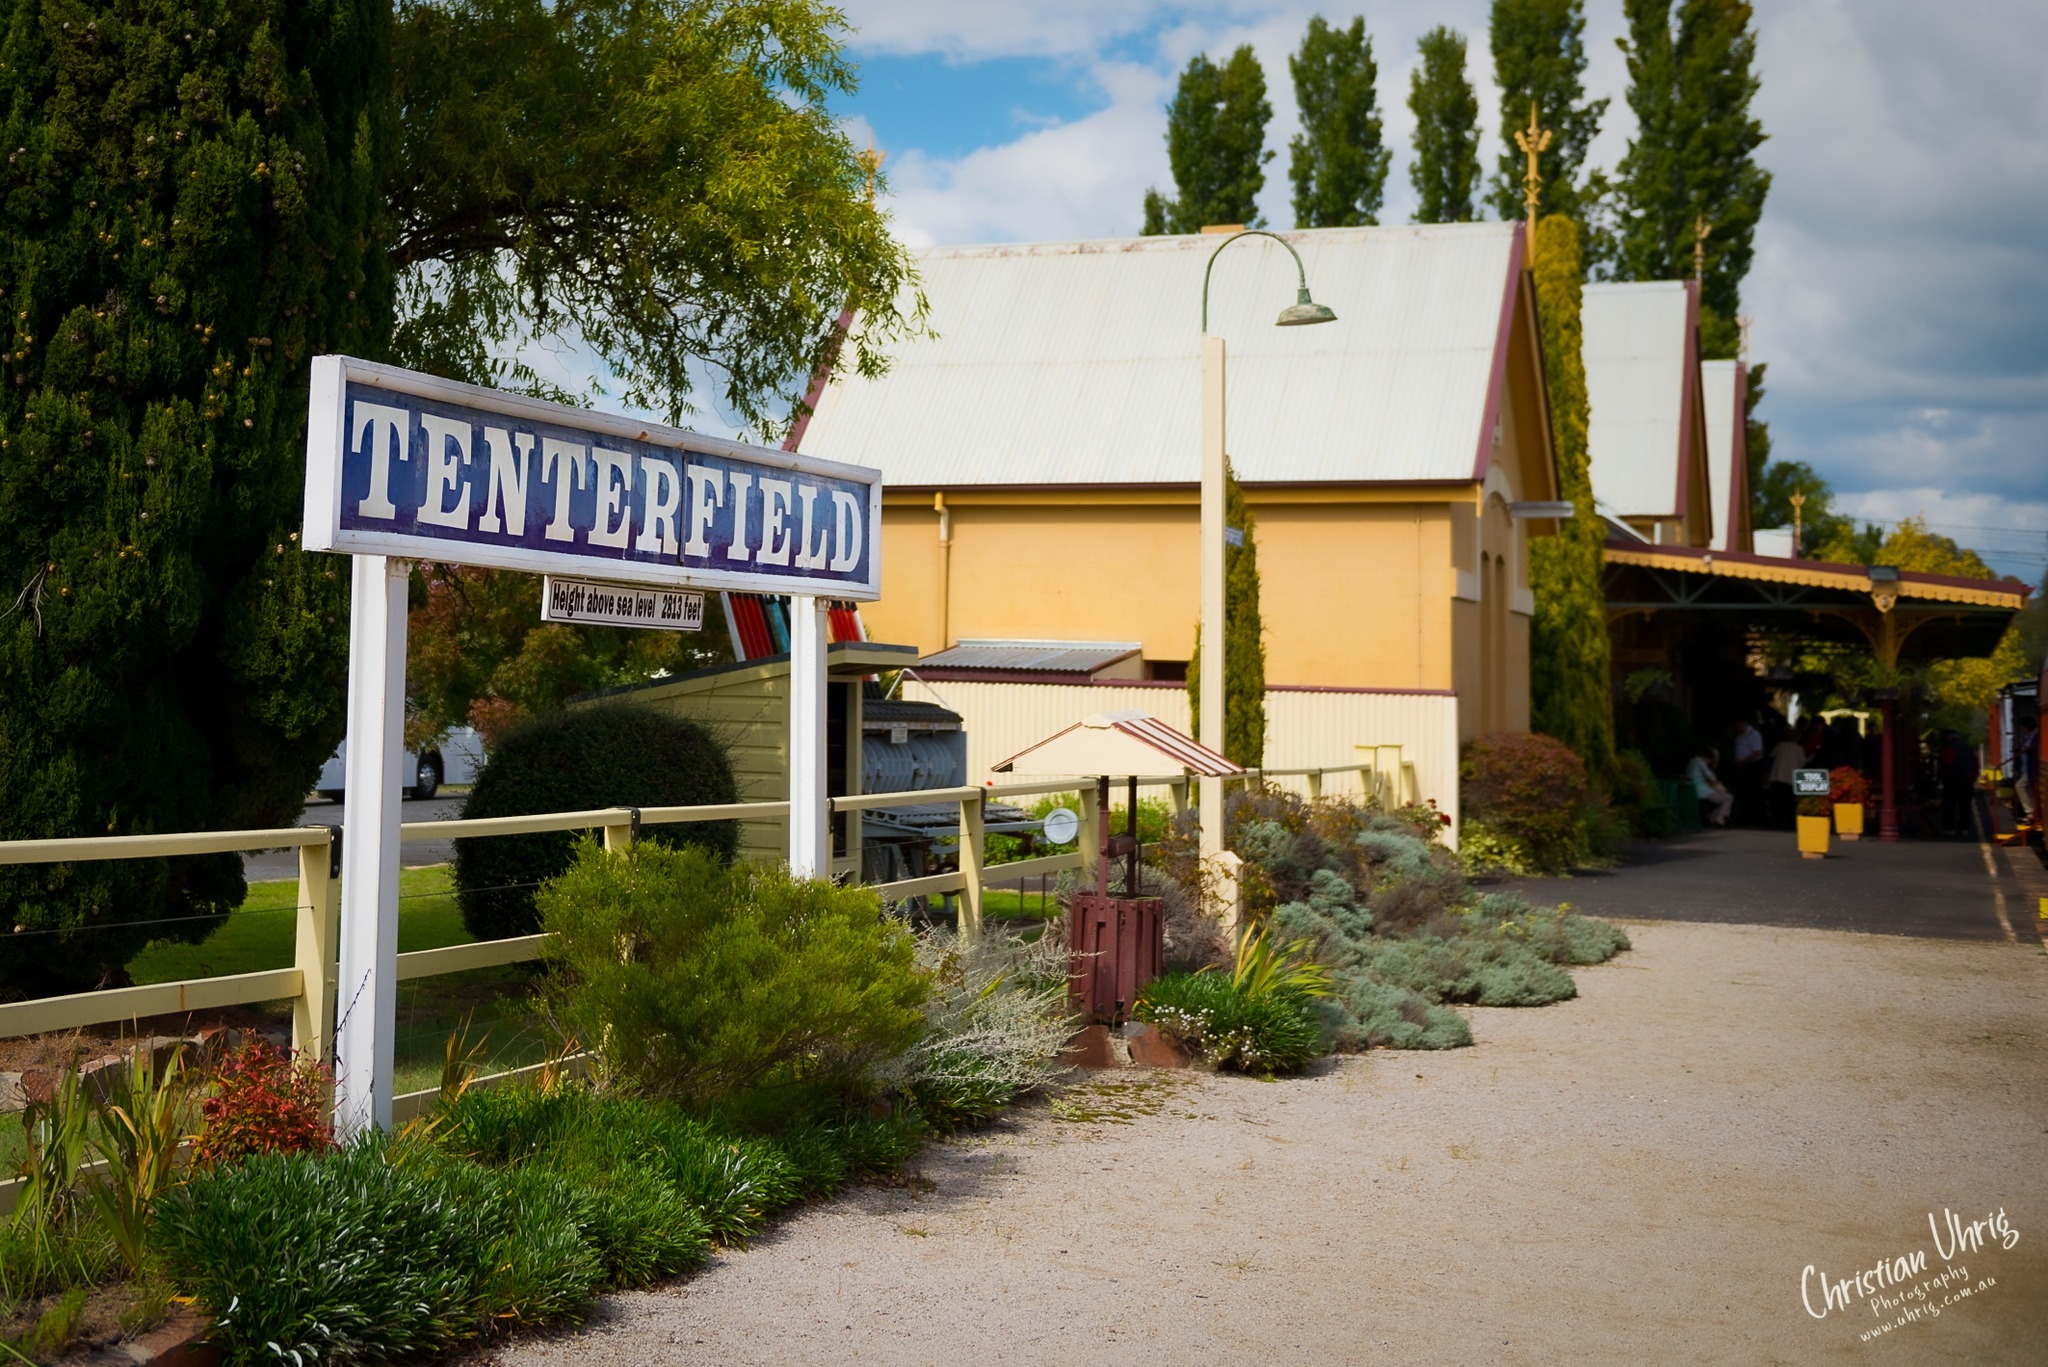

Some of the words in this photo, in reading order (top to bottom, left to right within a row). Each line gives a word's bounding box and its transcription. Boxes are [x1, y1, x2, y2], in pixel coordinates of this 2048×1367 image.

[351, 400, 862, 573] TENTERFIELD
[552, 582, 585, 617] Height
[586, 587, 614, 615] above
[616, 596, 633, 617] sea
[634, 592, 656, 618] level
[661, 594, 682, 619] 2813
[683, 595, 702, 621] feet
[1800, 783, 1828, 791] DISPLAY
